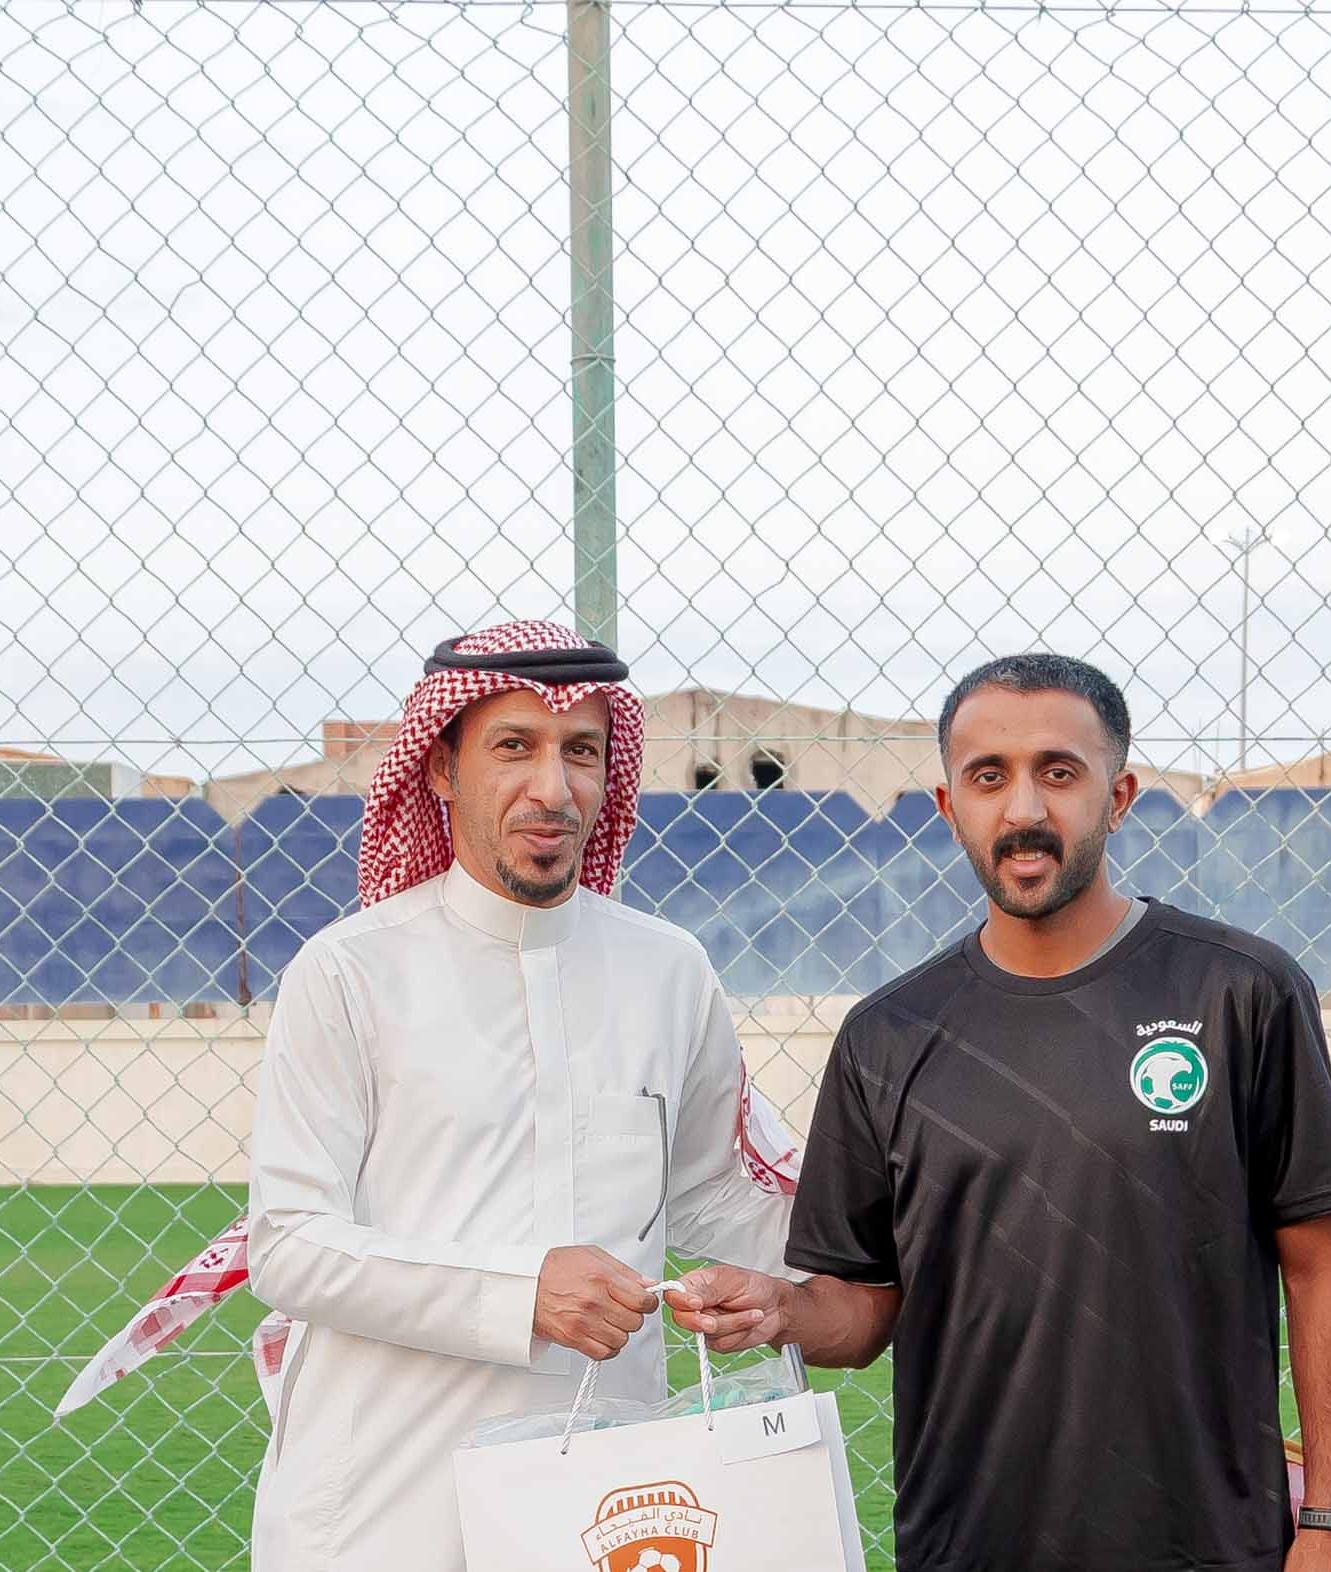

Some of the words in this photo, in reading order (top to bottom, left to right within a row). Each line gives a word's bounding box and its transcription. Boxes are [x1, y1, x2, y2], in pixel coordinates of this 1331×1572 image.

[1135, 1019, 1203, 1036] السعودية
[1149, 1119, 1189, 1132] SAUDI
[762, 1411, 786, 1437] M
[599, 1525, 659, 1553] ALFAYHA
[664, 1524, 700, 1539] CLUB
